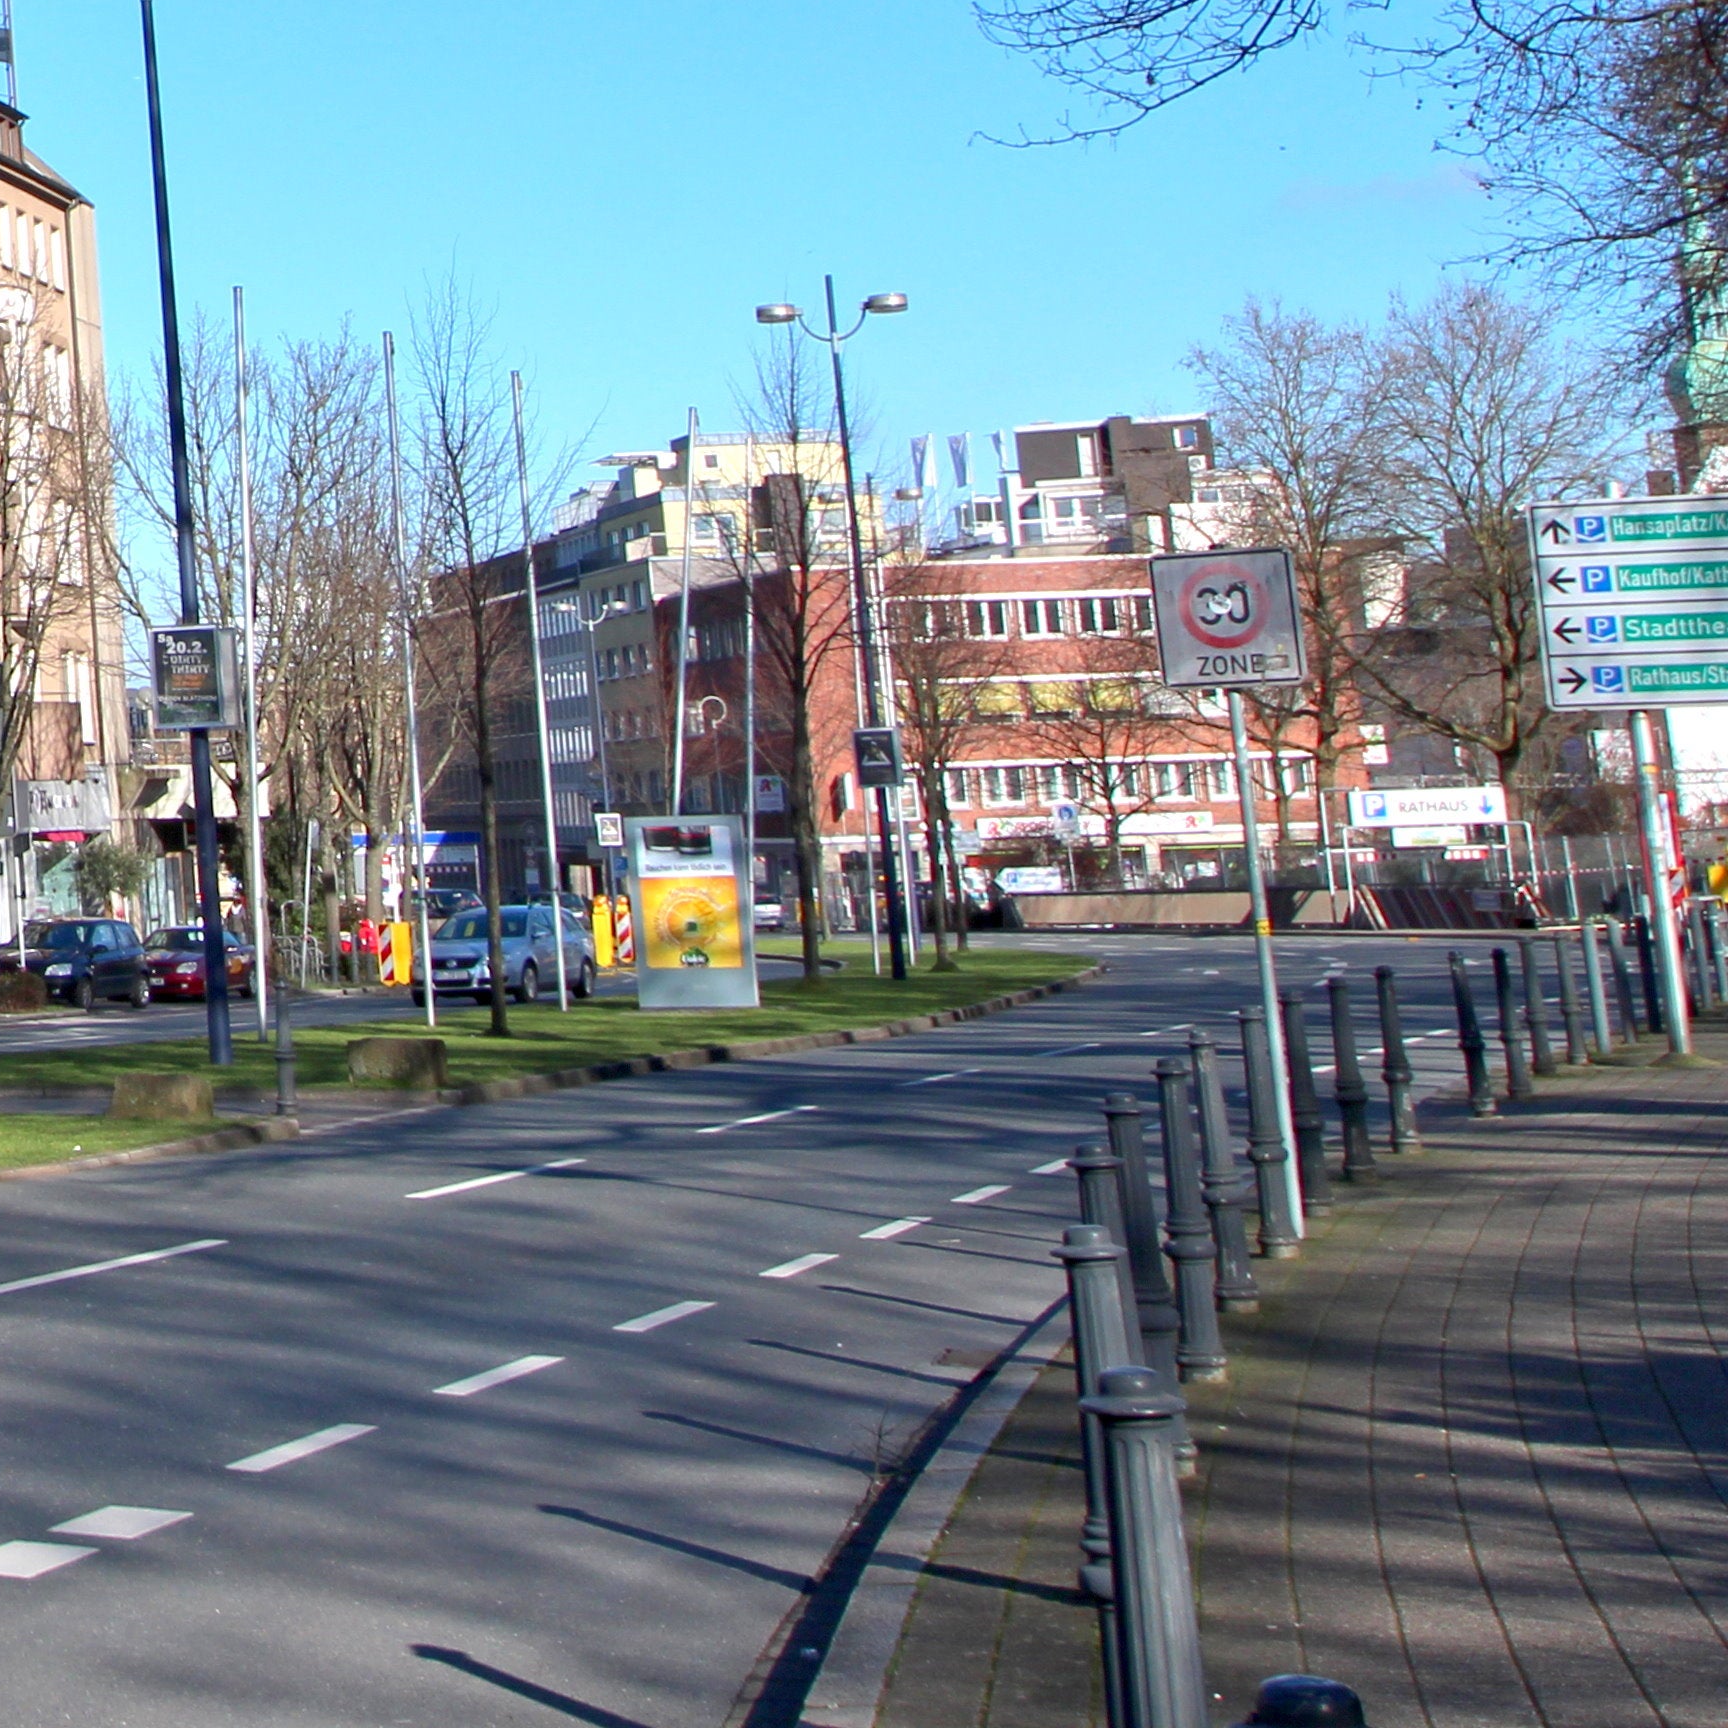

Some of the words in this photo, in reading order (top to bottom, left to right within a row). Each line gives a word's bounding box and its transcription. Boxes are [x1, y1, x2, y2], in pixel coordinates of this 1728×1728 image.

[1612, 512, 1728, 538] Hansaplatz/K
[1196, 581, 1250, 626] 30
[1625, 617, 1728, 638] Stadtthe
[166, 640, 208, 654] 20.2.
[1196, 652, 1266, 677] ZONE
[1630, 665, 1728, 687] Rathaus/St
[1398, 799, 1469, 813] RATHAUS
